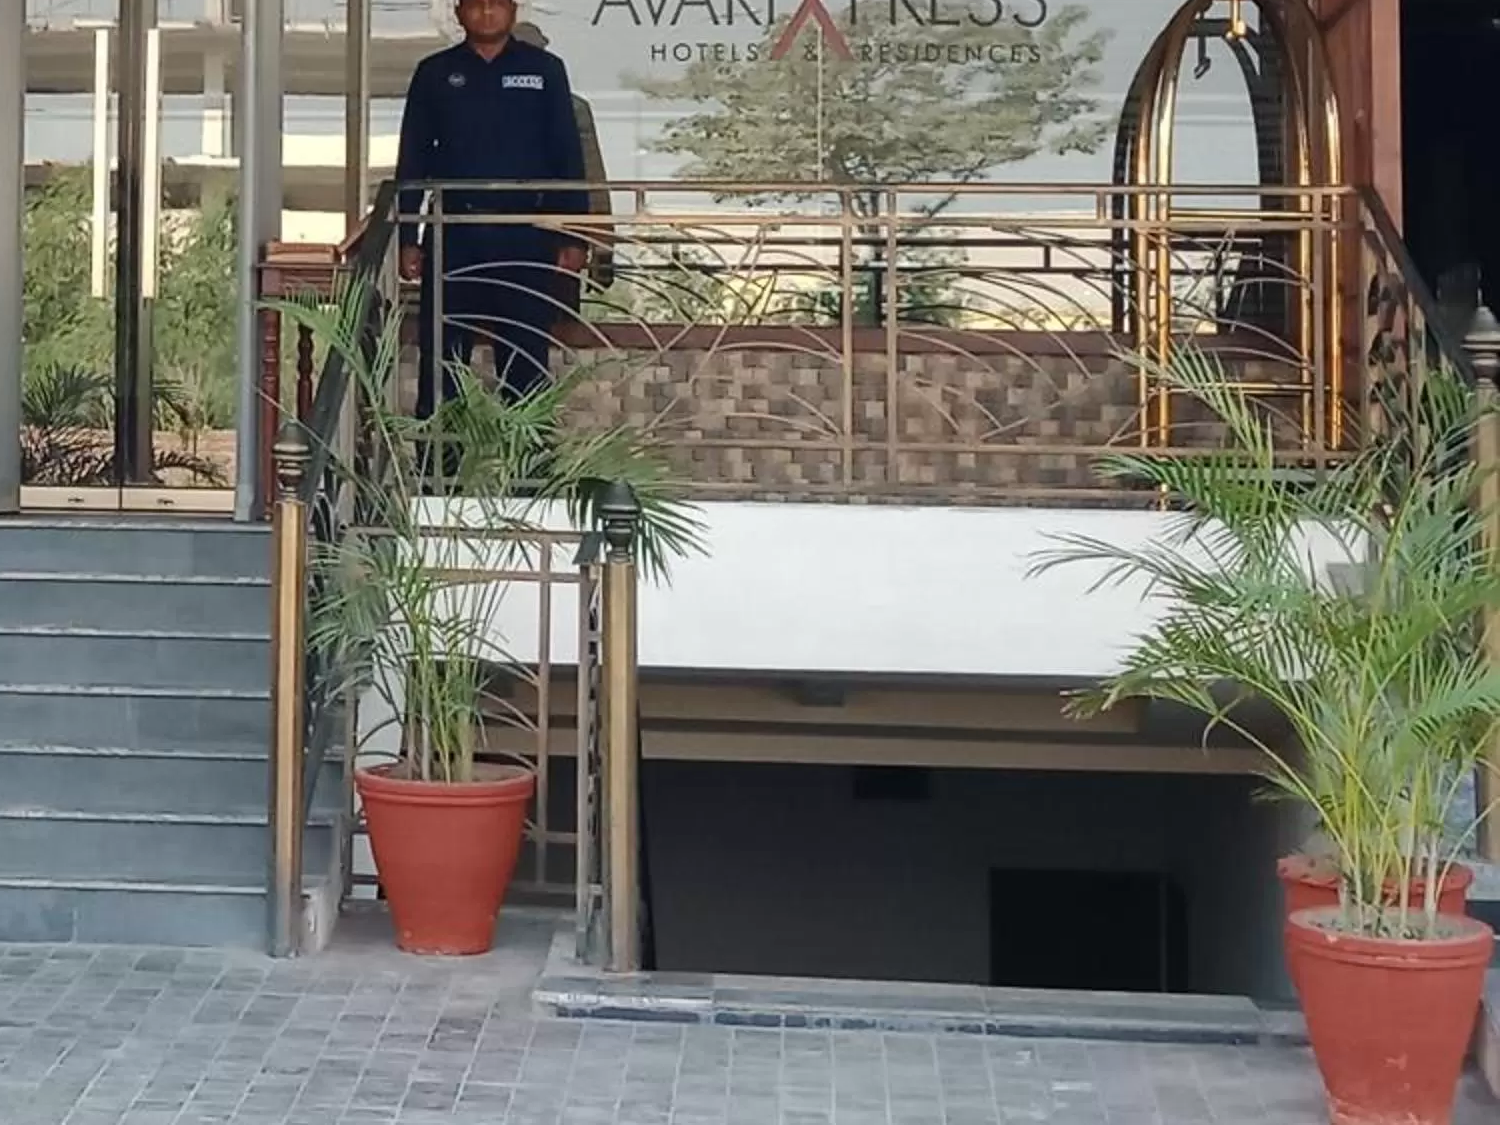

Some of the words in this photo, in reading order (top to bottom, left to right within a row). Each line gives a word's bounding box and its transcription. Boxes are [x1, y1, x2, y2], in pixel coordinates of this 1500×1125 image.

[651, 43, 759, 62] HOTELS
[803, 43, 819, 62] &
[860, 43, 1041, 63] RESIDENCES
